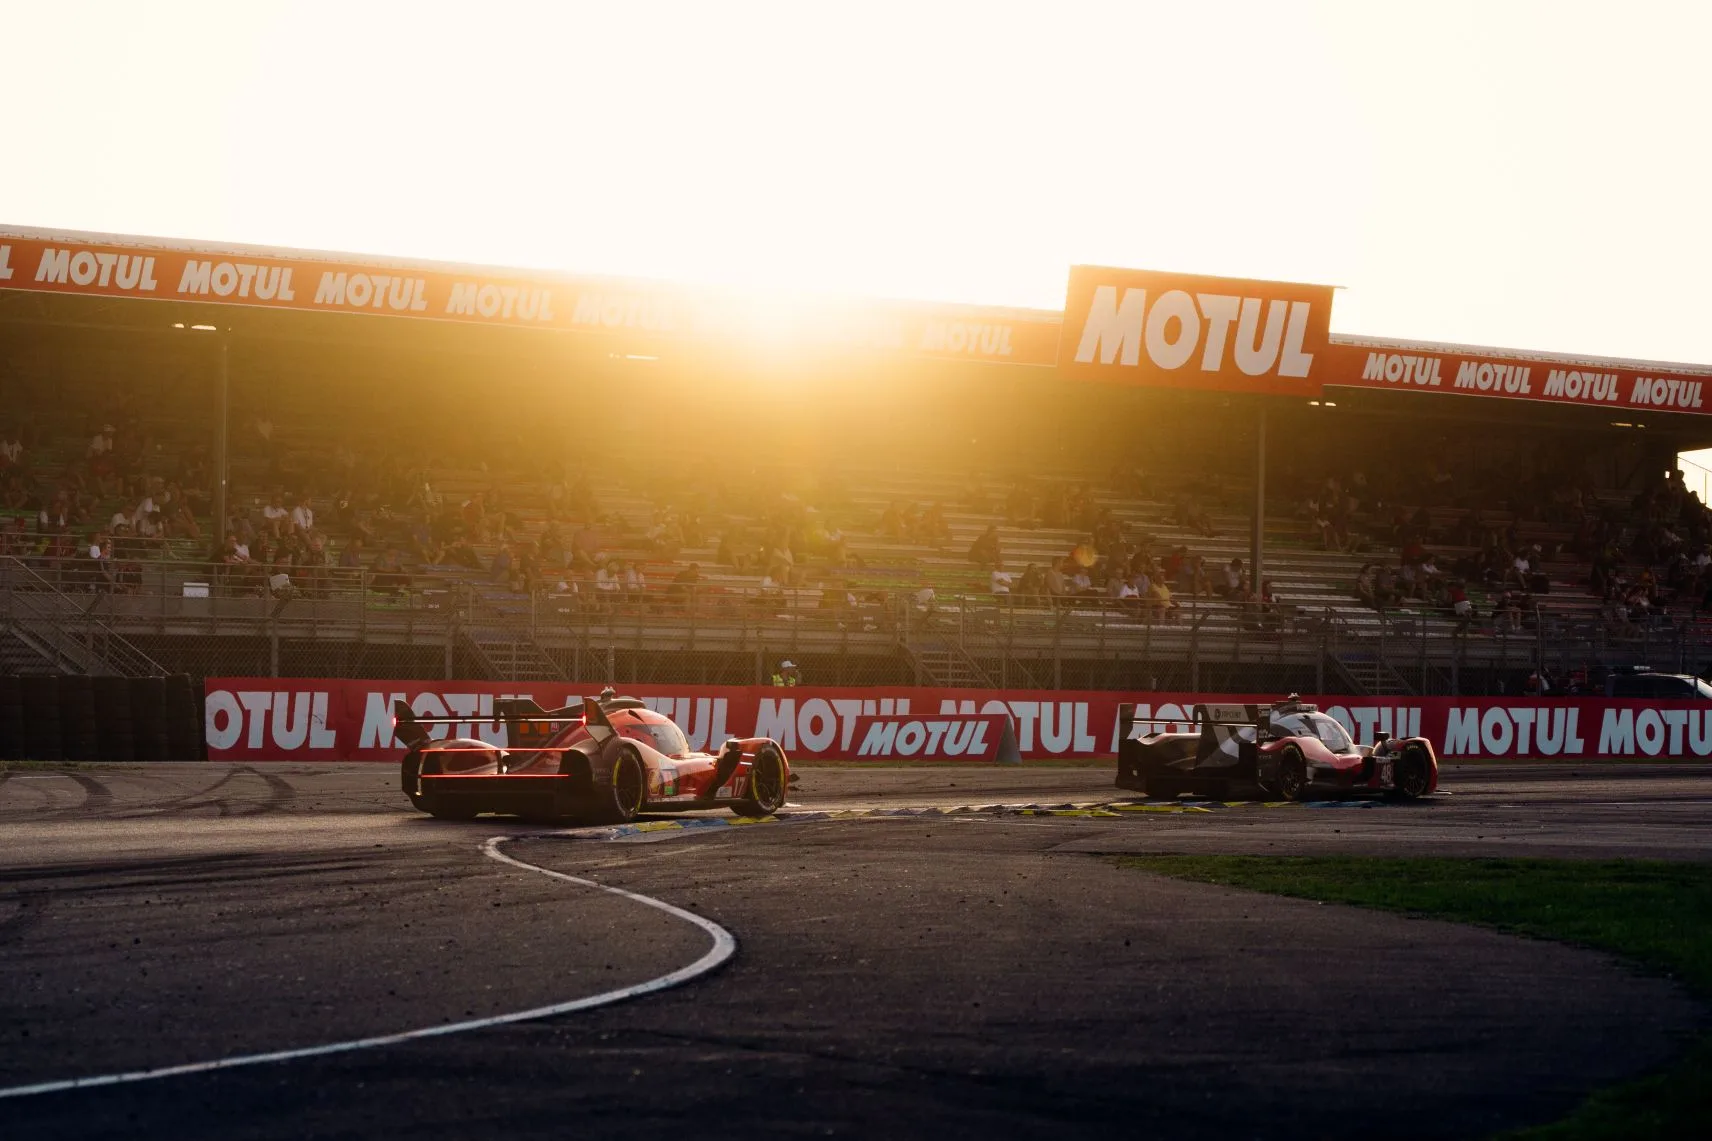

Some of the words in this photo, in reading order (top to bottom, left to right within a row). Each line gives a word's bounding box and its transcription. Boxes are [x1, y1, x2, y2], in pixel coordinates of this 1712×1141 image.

[35, 248, 157, 291] MOTUL
[177, 260, 295, 301] MOTUL
[314, 271, 428, 311] MOTUL
[445, 282, 555, 321] MOTUL
[572, 292, 674, 331] MOTU
[921, 320, 1014, 356] MOTUL
[1074, 285, 1314, 377] MOTUL
[1362, 352, 1442, 386] MOTUL
[1454, 361, 1531, 394] MOTUL
[1543, 369, 1619, 401] MOTUL
[1630, 377, 1703, 408] MOTUL
[358, 691, 533, 749] MOTU
[753, 698, 910, 752] MOT
[1443, 706, 1584, 756] MOTUL
[857, 720, 989, 756] MOTUL
[733, 776, 746, 796] 17
